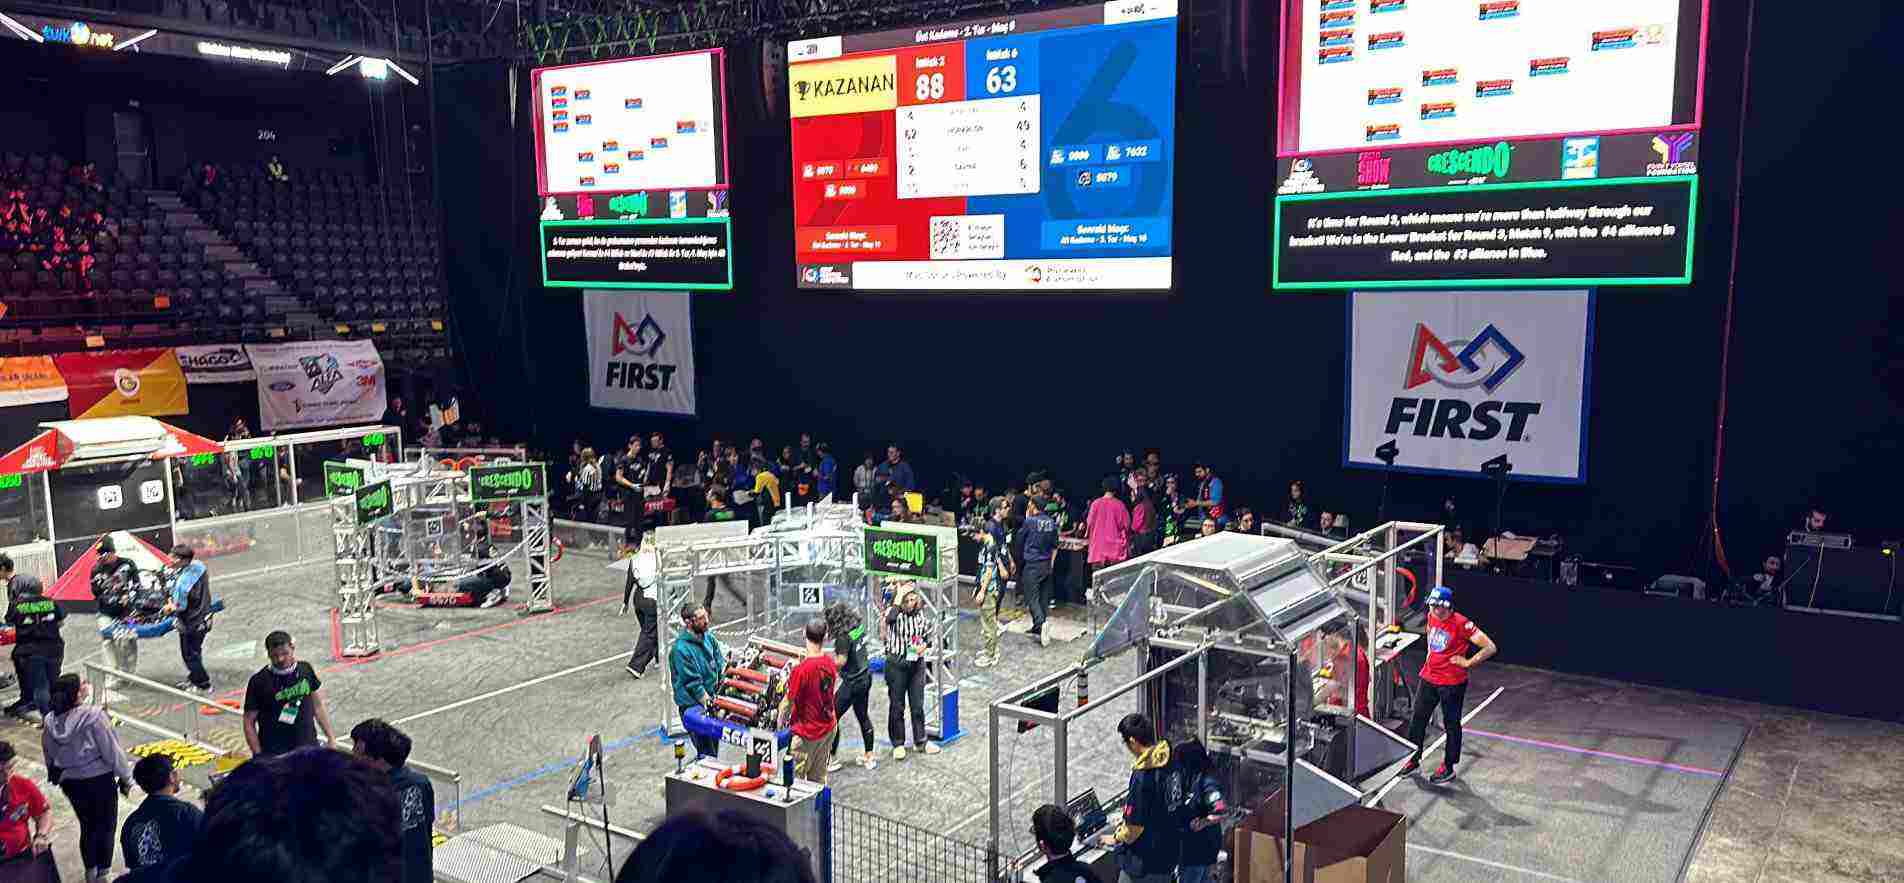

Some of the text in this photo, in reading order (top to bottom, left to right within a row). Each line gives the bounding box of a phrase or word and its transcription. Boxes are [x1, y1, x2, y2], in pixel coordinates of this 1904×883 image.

[814, 73, 895, 98] KAZANAN
[916, 73, 944, 100] 88
[986, 65, 1017, 94] 63
[258, 129, 276, 141] 204
[1358, 158, 1392, 184] SHOW
[1428, 141, 1510, 177] CRESCENDO
[1322, 216, 1344, 228] time
[1345, 216, 1358, 228] for
[1359, 214, 1390, 228] Round
[1401, 212, 1430, 226] which
[1430, 213, 1463, 224] means
[1464, 210, 1492, 222] we're
[1493, 210, 1520, 222] more
[1520, 208, 1544, 220] than
[1546, 206, 1586, 221] halfway
[1588, 204, 1632, 218] through
[1632, 206, 1654, 216] our
[1326, 234, 1352, 246] We're
[1352, 234, 1363, 244] in
[1364, 232, 1380, 244] the
[1380, 232, 1408, 244] Lower
[1409, 231, 1448, 243] Bracket
[1448, 230, 1463, 241] for
[1464, 228, 1496, 241] Round
[1508, 227, 1542, 240] Match
[1543, 226, 1554, 240] 9,
[1555, 226, 1578, 238] with
[1578, 225, 1598, 238] the
[1601, 224, 1618, 238] #4
[1618, 224, 1662, 236] alliance
[1662, 224, 1676, 236] in
[1392, 246, 1548, 262] Red, and the #3 alliance in Blue.
[356, 375, 376, 386] 3M
[606, 362, 676, 392] FIRST
[1384, 396, 1542, 442] FIRST
[480, 468, 532, 490] CRESCENDO
[873, 538, 924, 566] CRESCENDO
